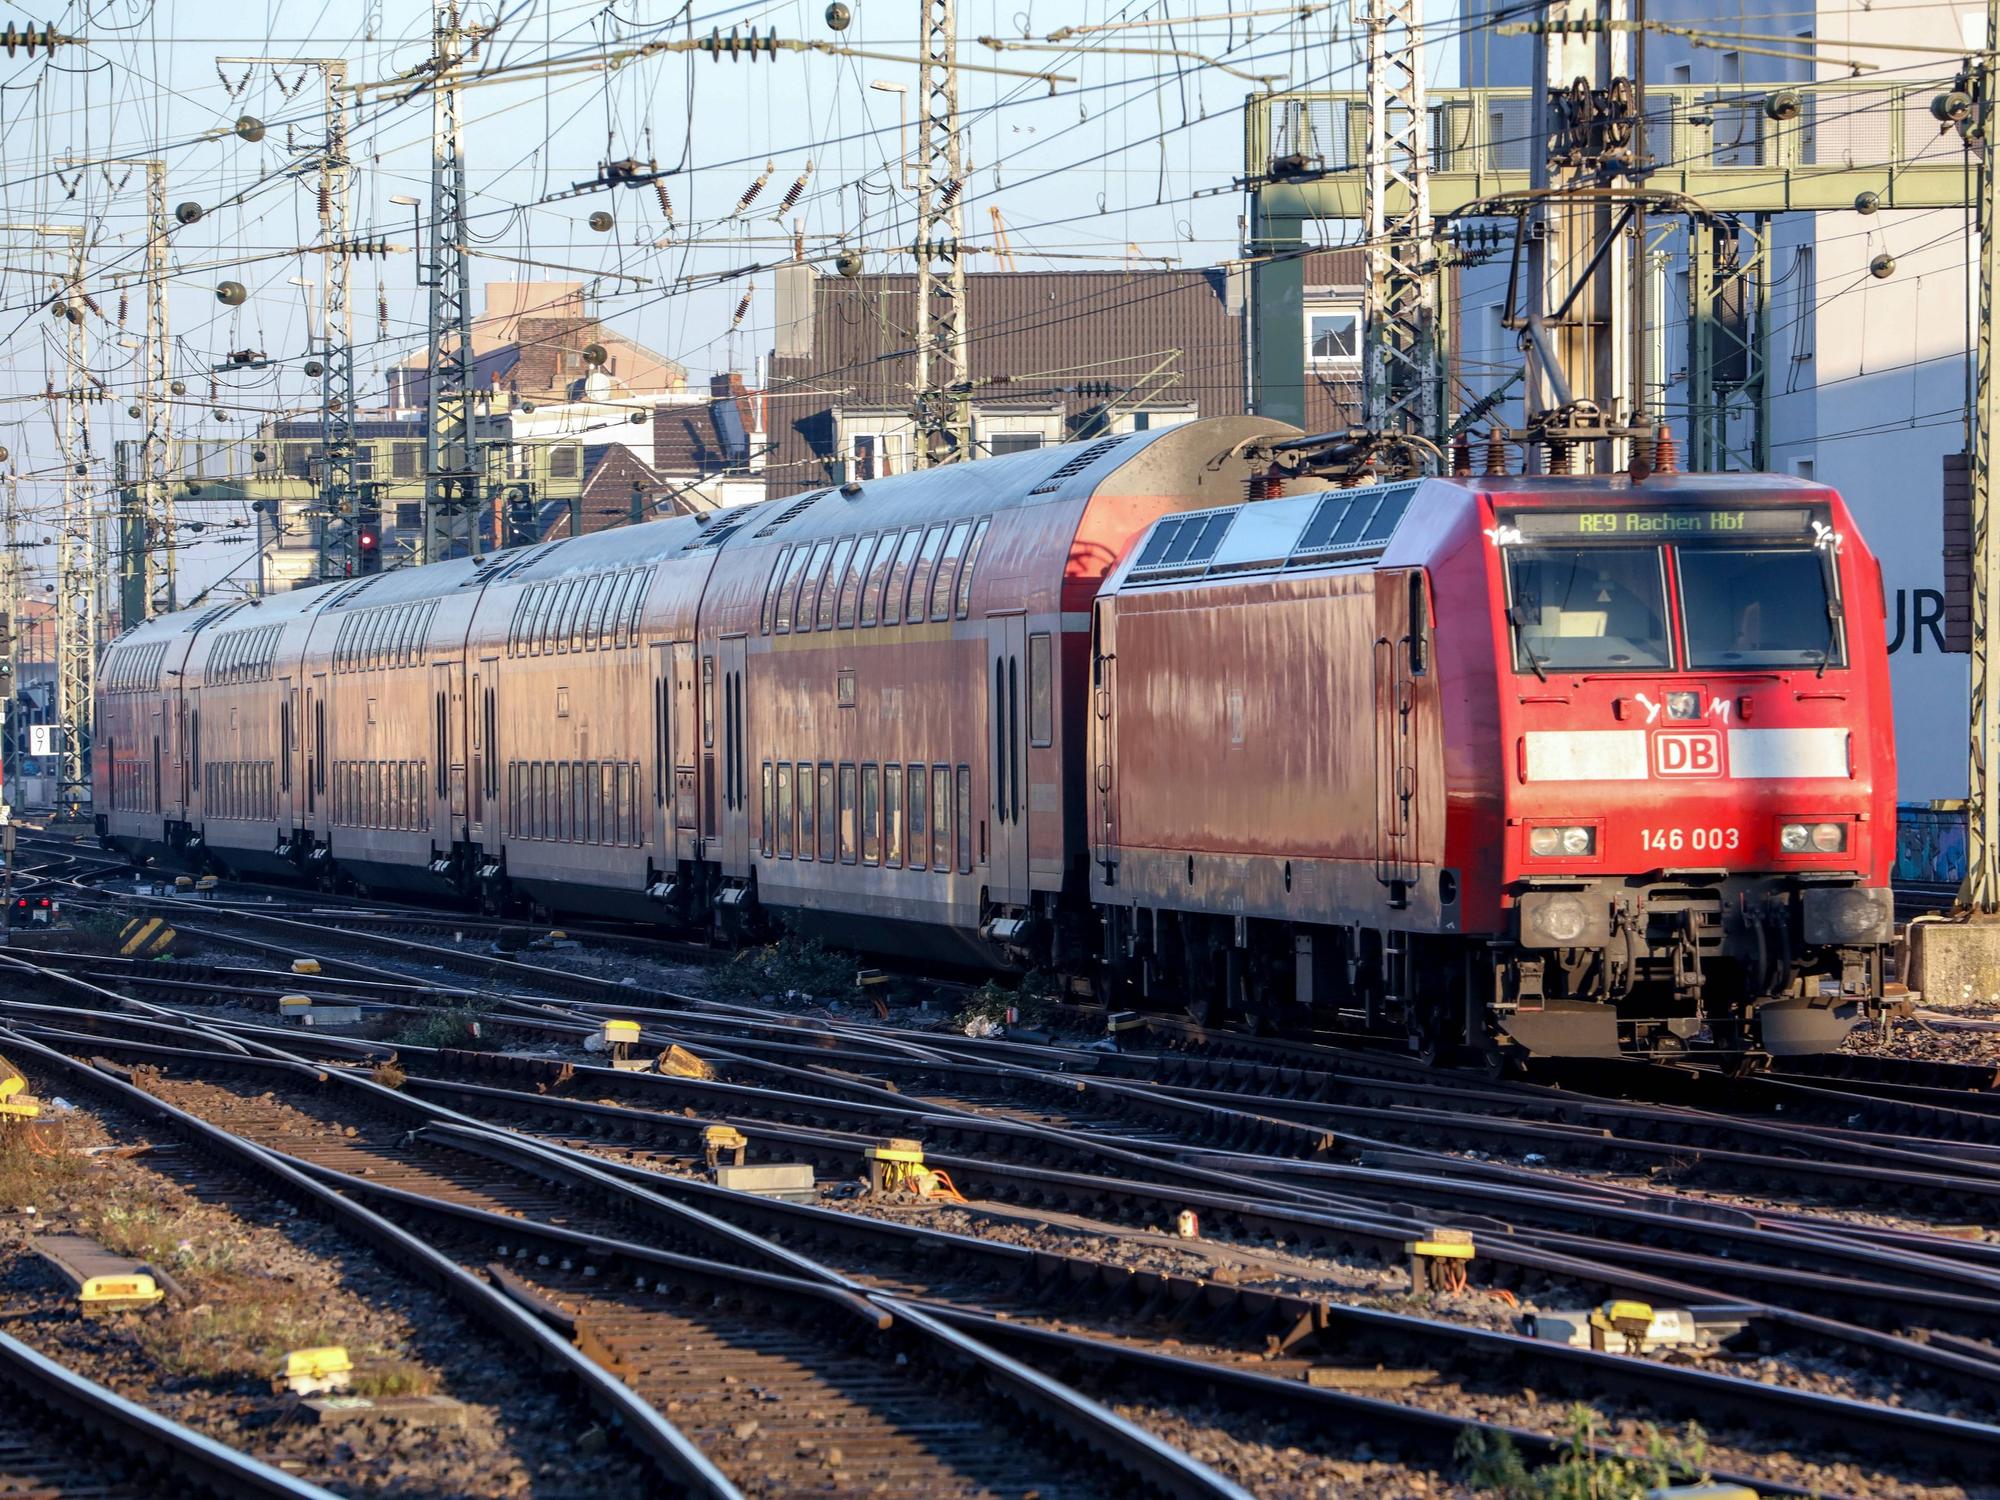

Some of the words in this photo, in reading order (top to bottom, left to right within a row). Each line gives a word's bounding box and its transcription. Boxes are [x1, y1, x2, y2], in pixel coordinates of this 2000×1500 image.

[1579, 513, 1617, 532] RE9
[1626, 512, 1702, 531] Aachen
[1710, 511, 1745, 530] Hbf
[1662, 738, 1714, 770] DB
[1641, 828, 1684, 851] 146
[1692, 827, 1740, 850] 003
